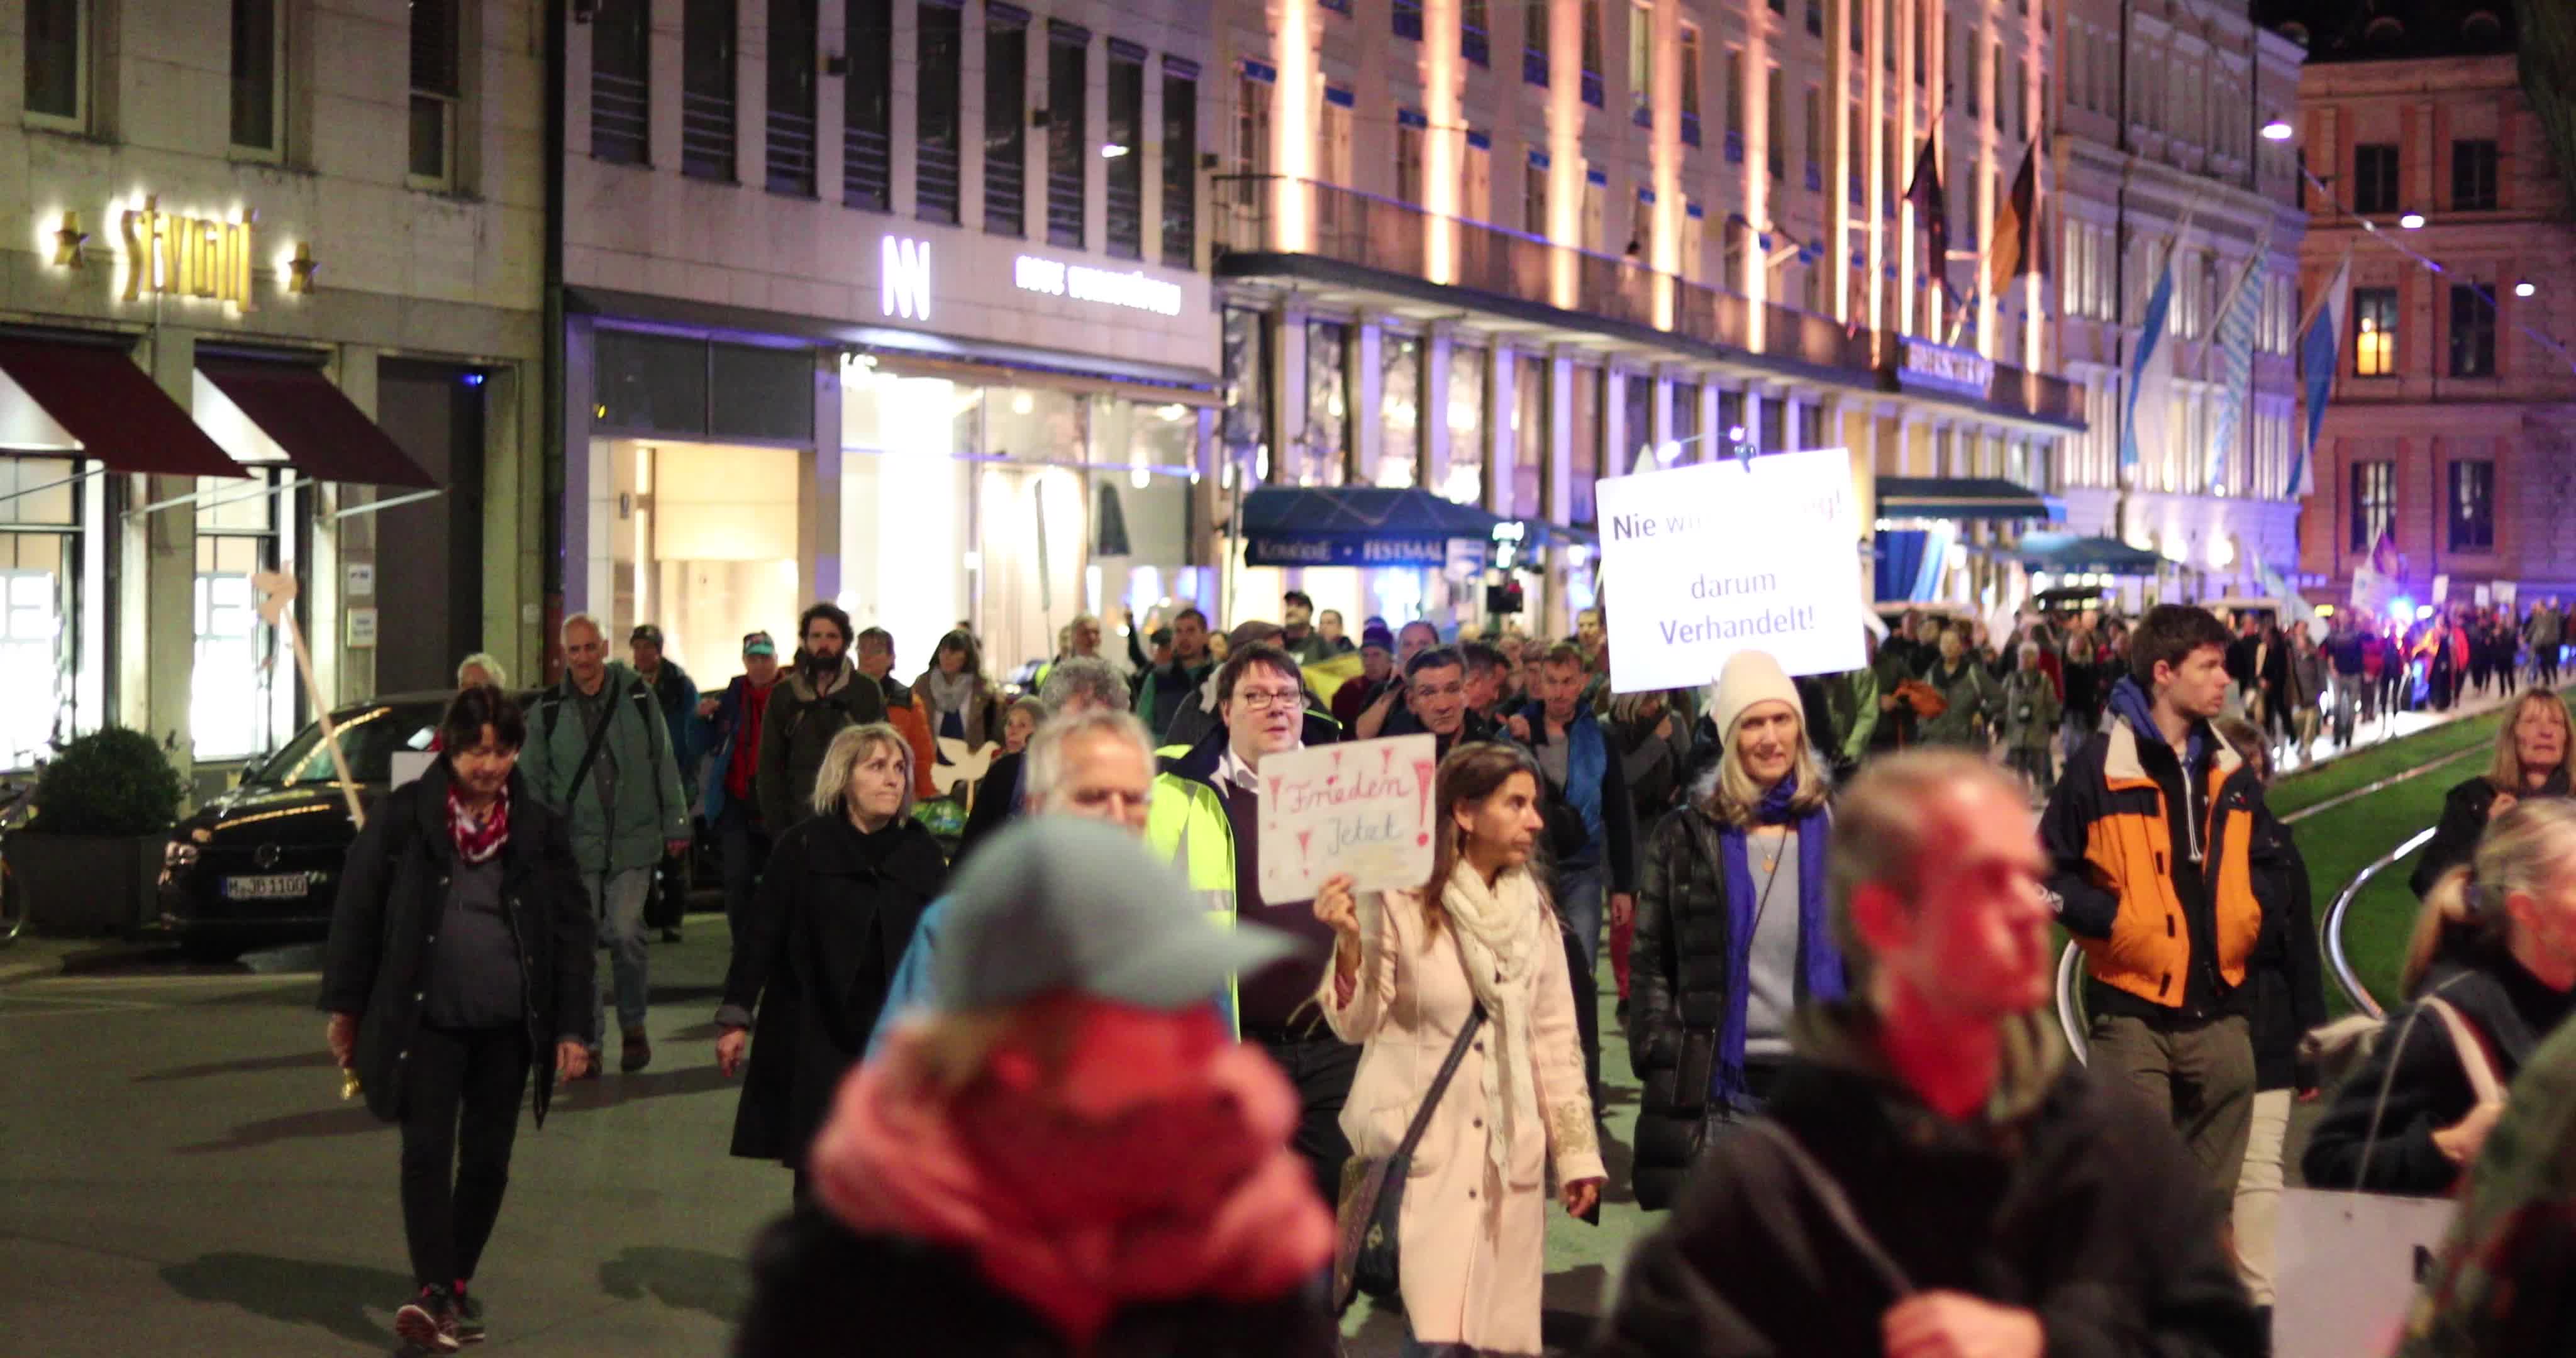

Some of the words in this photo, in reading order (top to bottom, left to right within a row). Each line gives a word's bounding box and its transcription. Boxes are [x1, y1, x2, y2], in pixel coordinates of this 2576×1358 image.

[1613, 513, 1657, 541] Nie
[1690, 572, 1777, 599] darum
[1660, 605, 1816, 645] Verhandelt!
[1286, 771, 1411, 815] Frieden
[1327, 813, 1404, 855] Jetzt
